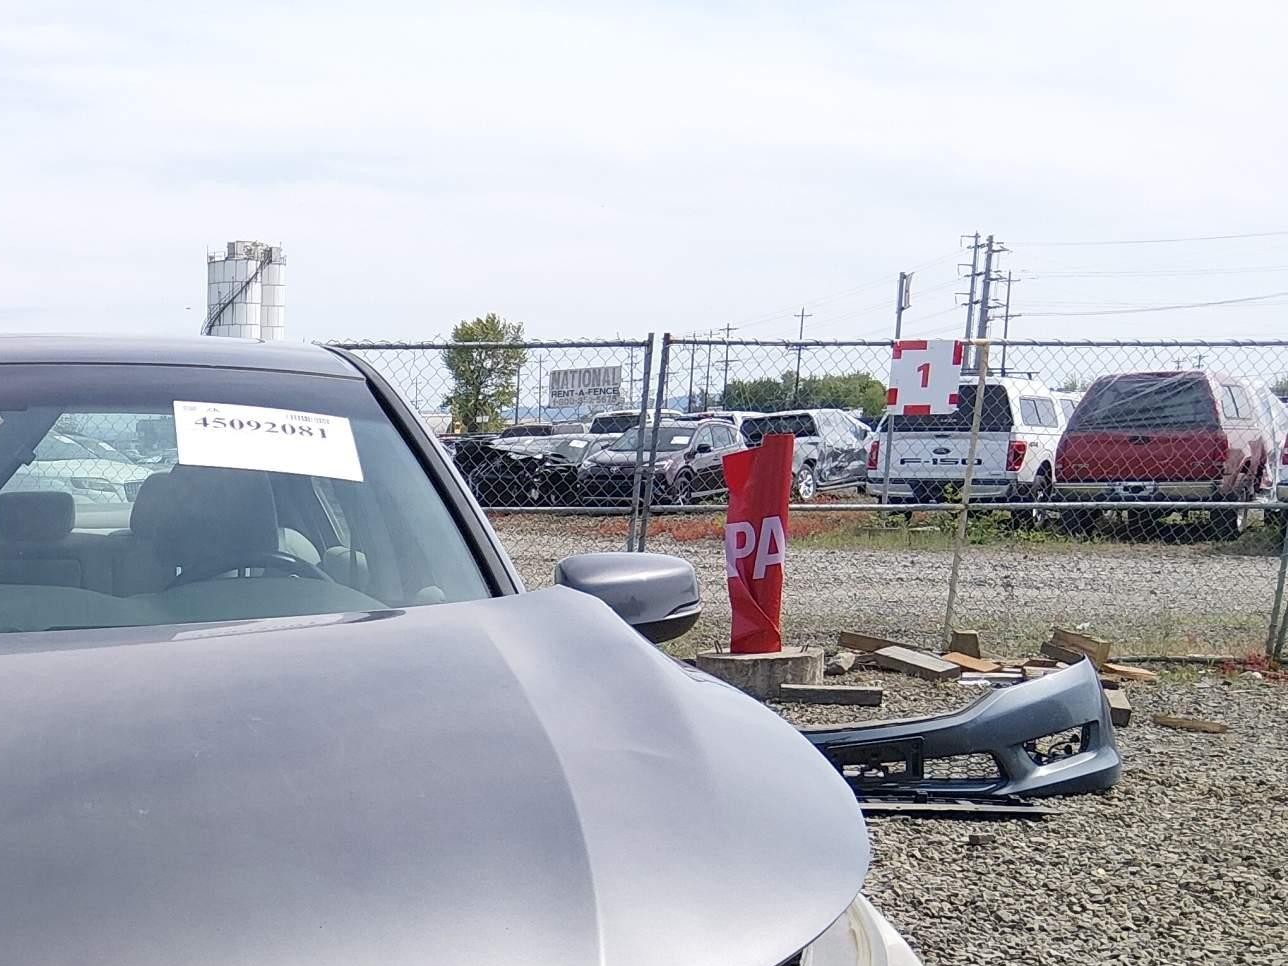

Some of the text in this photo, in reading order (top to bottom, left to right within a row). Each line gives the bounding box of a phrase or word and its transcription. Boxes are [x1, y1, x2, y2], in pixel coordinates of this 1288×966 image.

[551, 368, 618, 389] NATIONAL
[916, 362, 931, 389] 1
[551, 387, 619, 398] RENT-A-FENCE
[194, 415, 328, 439] 45092081
[900, 457, 983, 466] F-150
[725, 515, 785, 579] PA
